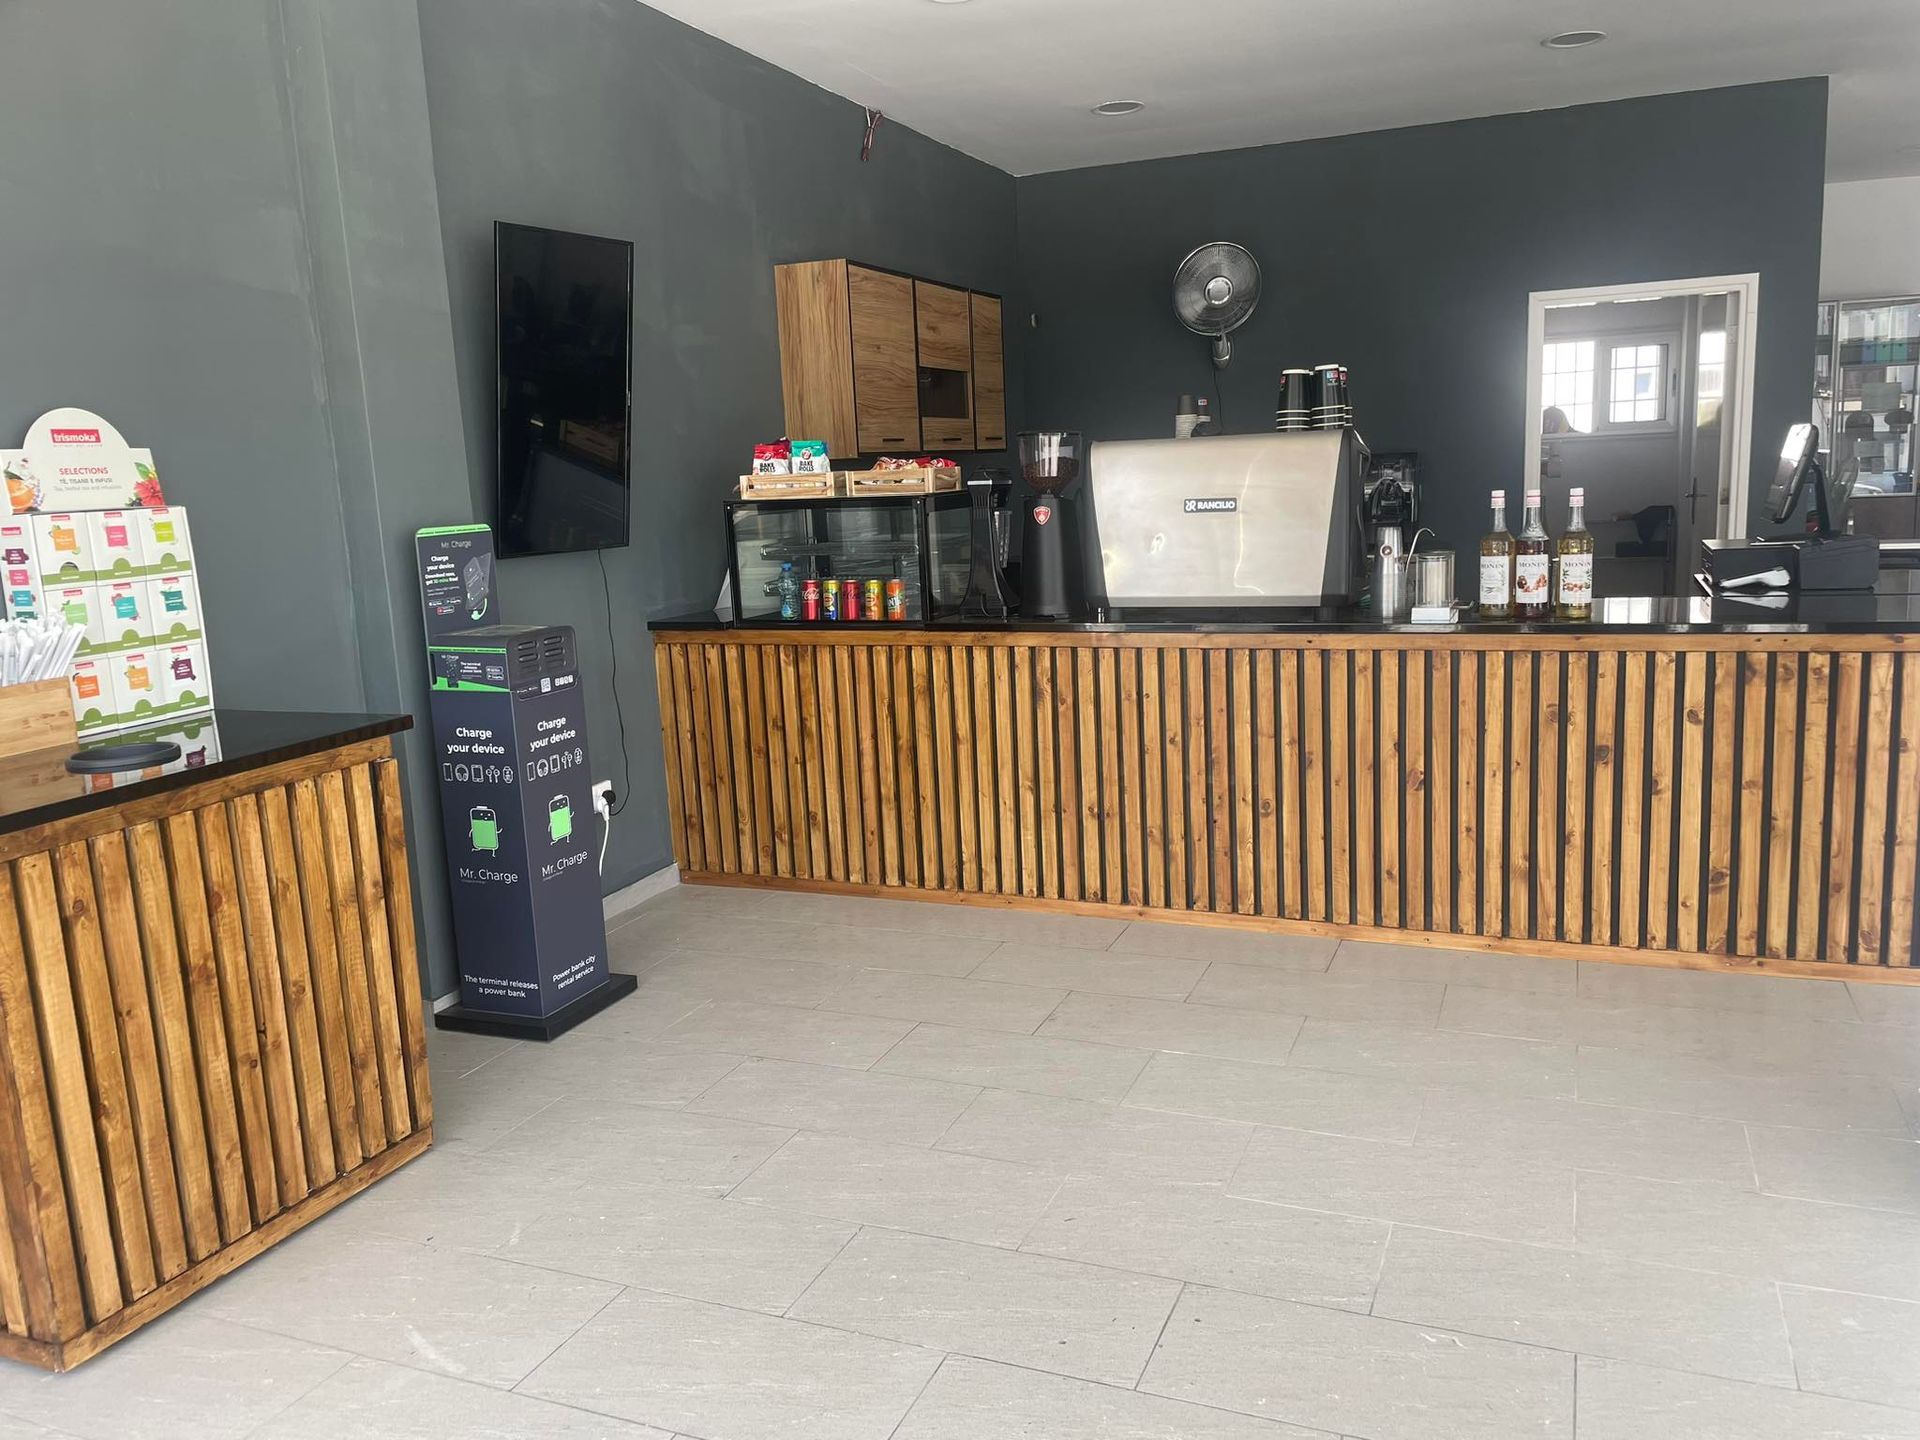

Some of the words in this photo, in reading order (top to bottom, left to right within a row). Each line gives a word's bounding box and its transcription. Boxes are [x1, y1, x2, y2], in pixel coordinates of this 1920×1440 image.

[53, 433, 97, 442] trismoka
[59, 467, 109, 475] SELECTIONS
[1197, 501, 1236, 509] RANCILIO
[537, 717, 567, 732] Charge
[456, 727, 493, 740] Charge
[530, 737, 549, 752] your
[550, 729, 576, 744] device
[447, 744, 469, 754] your
[471, 743, 505, 754] device
[542, 864, 556, 877] Mr.
[557, 851, 588, 870] Charge
[459, 867, 477, 879] Mr.
[478, 869, 519, 884] Charge
[552, 968, 571, 983] Power
[571, 959, 585, 974] bank
[585, 955, 596, 965] city
[464, 974, 478, 984] The
[478, 976, 509, 987] terminal
[509, 980, 539, 990] releases
[557, 974, 575, 990] rental
[574, 965, 594, 981] service
[484, 988, 506, 997] power
[507, 988, 526, 998] bank
